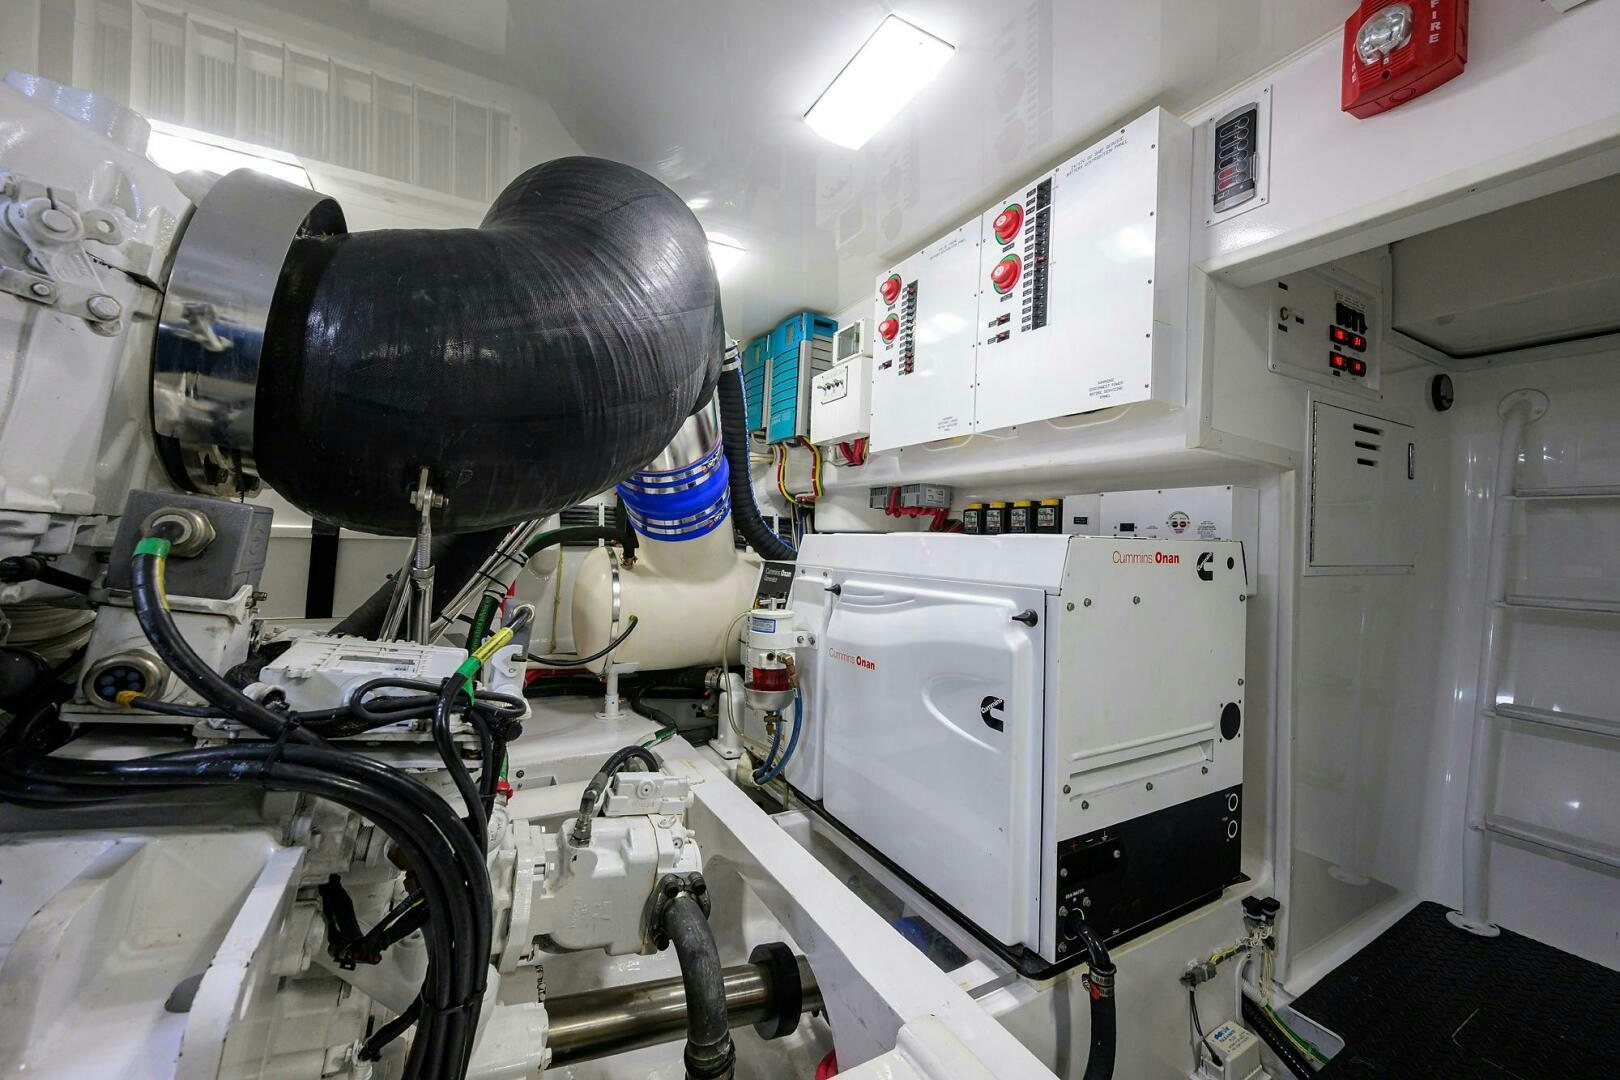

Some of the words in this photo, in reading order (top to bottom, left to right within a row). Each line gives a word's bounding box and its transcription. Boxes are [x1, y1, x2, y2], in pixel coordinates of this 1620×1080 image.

[1428, 0, 1441, 43] FIRE
[1112, 550, 1153, 564] Cummins
[1155, 551, 1180, 564] Onan
[781, 569, 792, 578] Onan
[829, 647, 856, 665] Cummins
[856, 655, 876, 671] Onan
